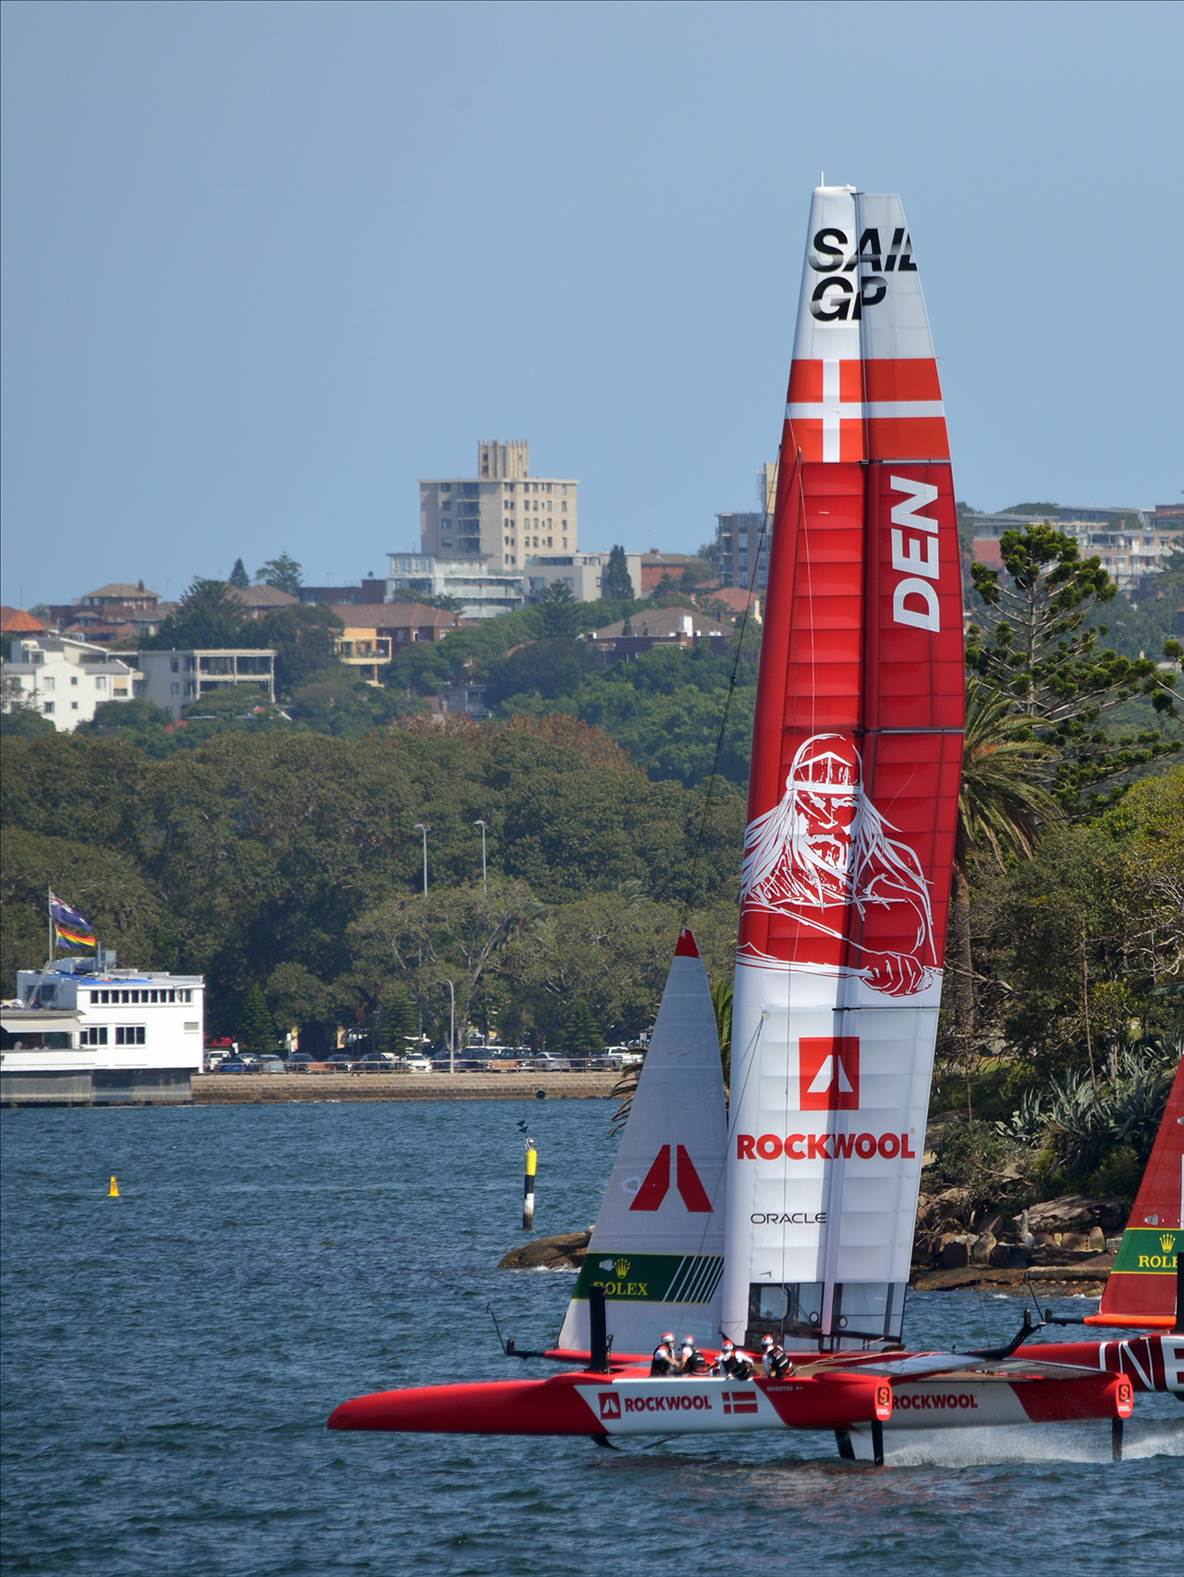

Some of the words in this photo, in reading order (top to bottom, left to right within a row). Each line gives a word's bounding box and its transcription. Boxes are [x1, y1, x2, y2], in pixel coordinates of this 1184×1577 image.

[808, 227, 918, 273] SAIL
[809, 276, 888, 322] GP
[890, 475, 941, 633] DEN
[736, 1132, 916, 1161] ROCKWOOL
[750, 1212, 828, 1224] ORACLE
[1138, 1255, 1178, 1268] ROLE
[624, 1395, 712, 1413] ROCKWOOL
[892, 1394, 978, 1410] ROCKWOOL
